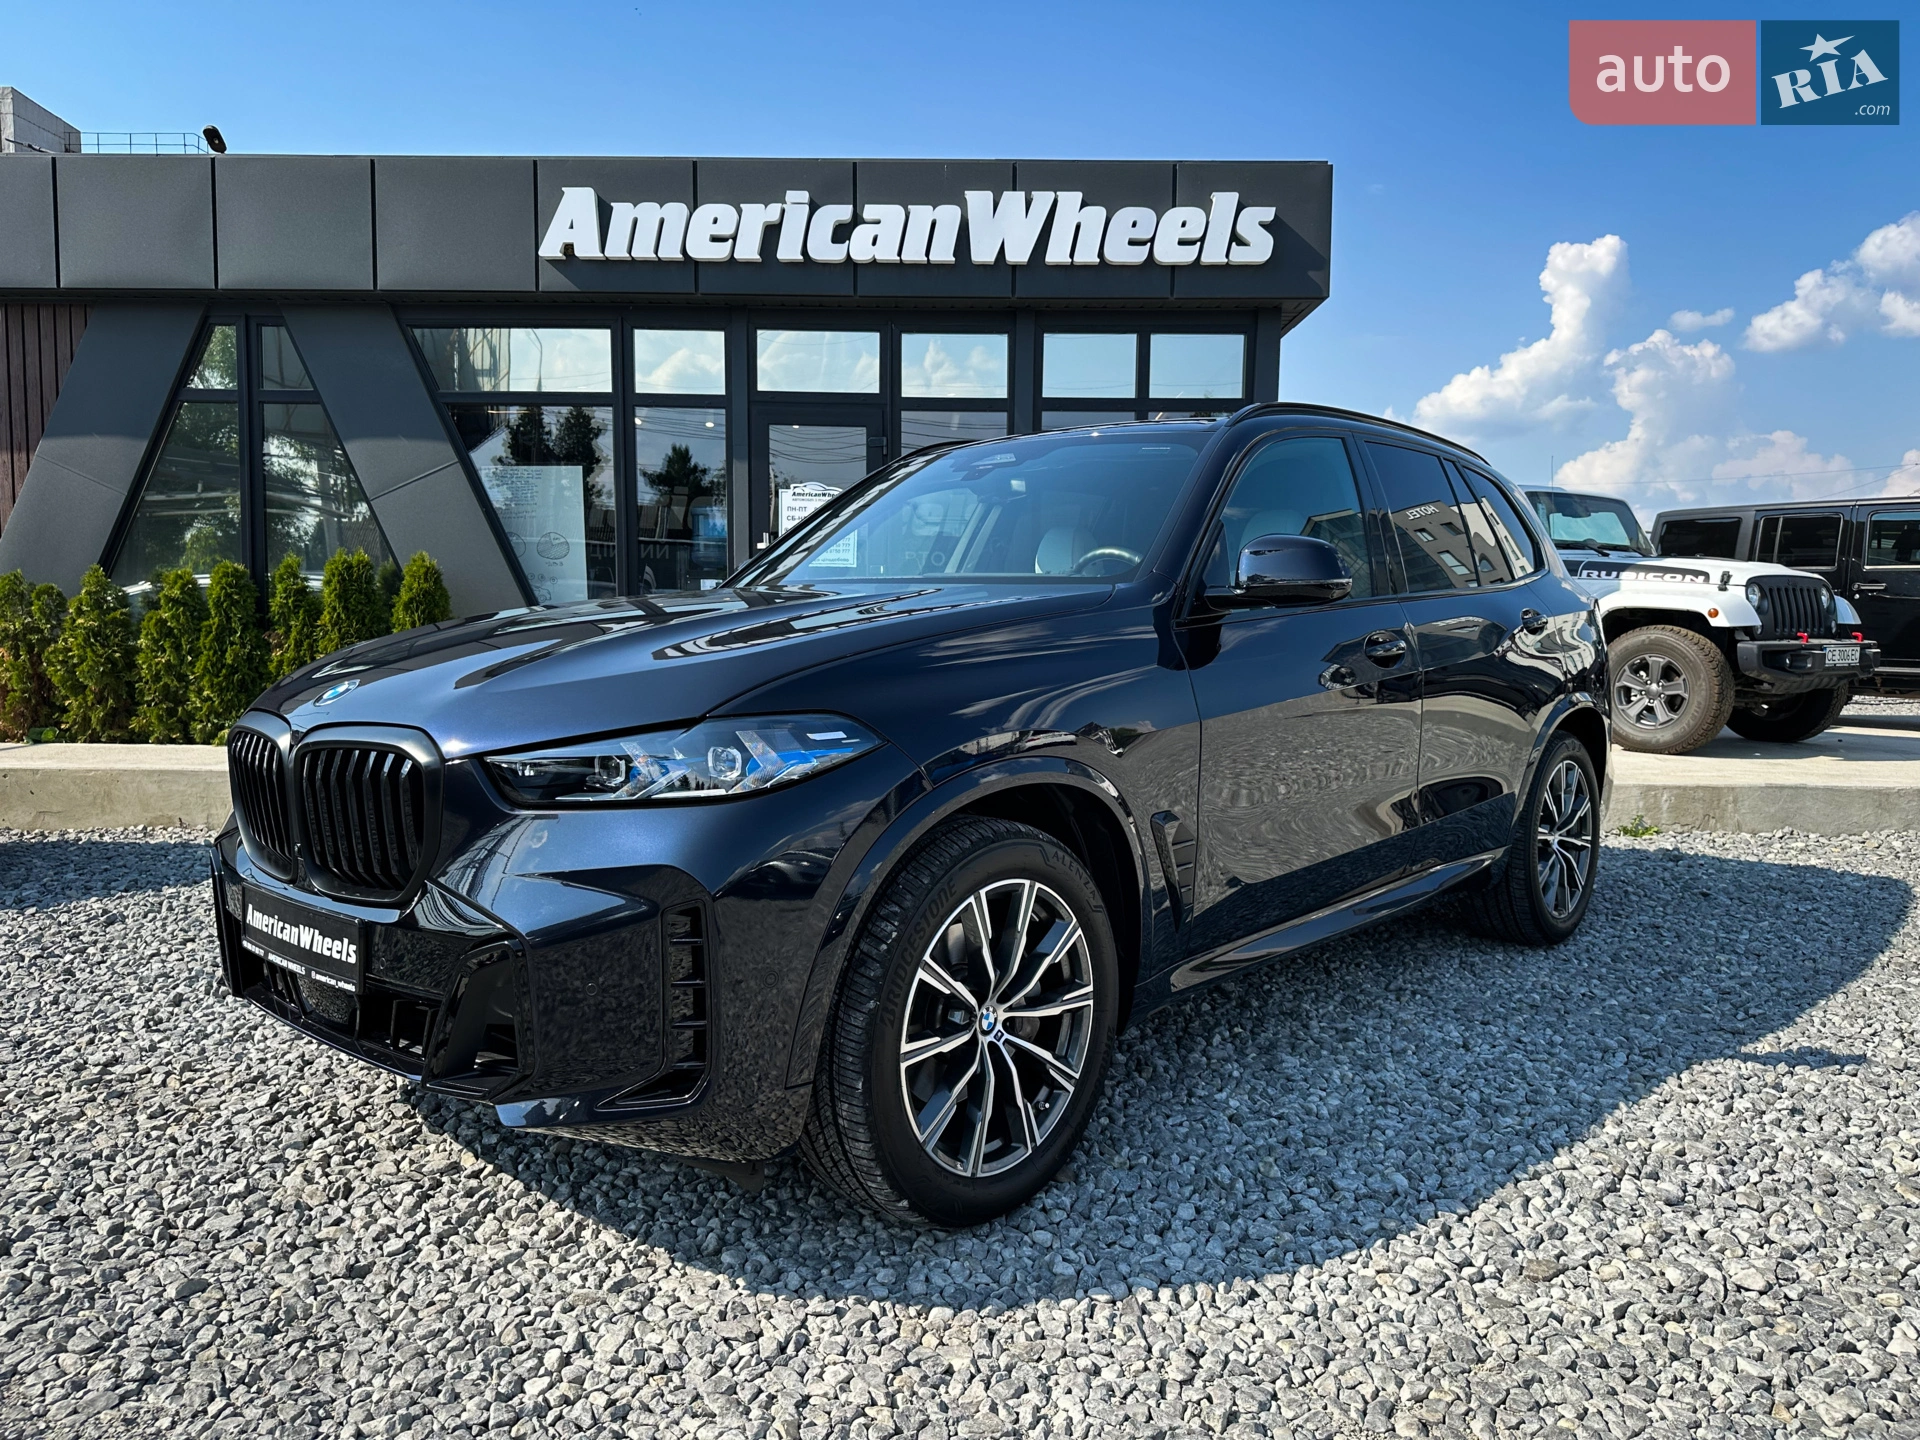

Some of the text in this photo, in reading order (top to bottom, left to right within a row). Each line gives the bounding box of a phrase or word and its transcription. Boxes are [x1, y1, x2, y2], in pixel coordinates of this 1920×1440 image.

[538, 186, 1277, 266] AmericanWheels
[1581, 570, 1706, 584] RUBICON
[1826, 649, 1837, 662] CE
[1837, 649, 1851, 662] 3006
[1052, 850, 1096, 901] ALENZA
[246, 903, 357, 965] AmericanWheels
[879, 876, 958, 1029] BRIDGESTONE
